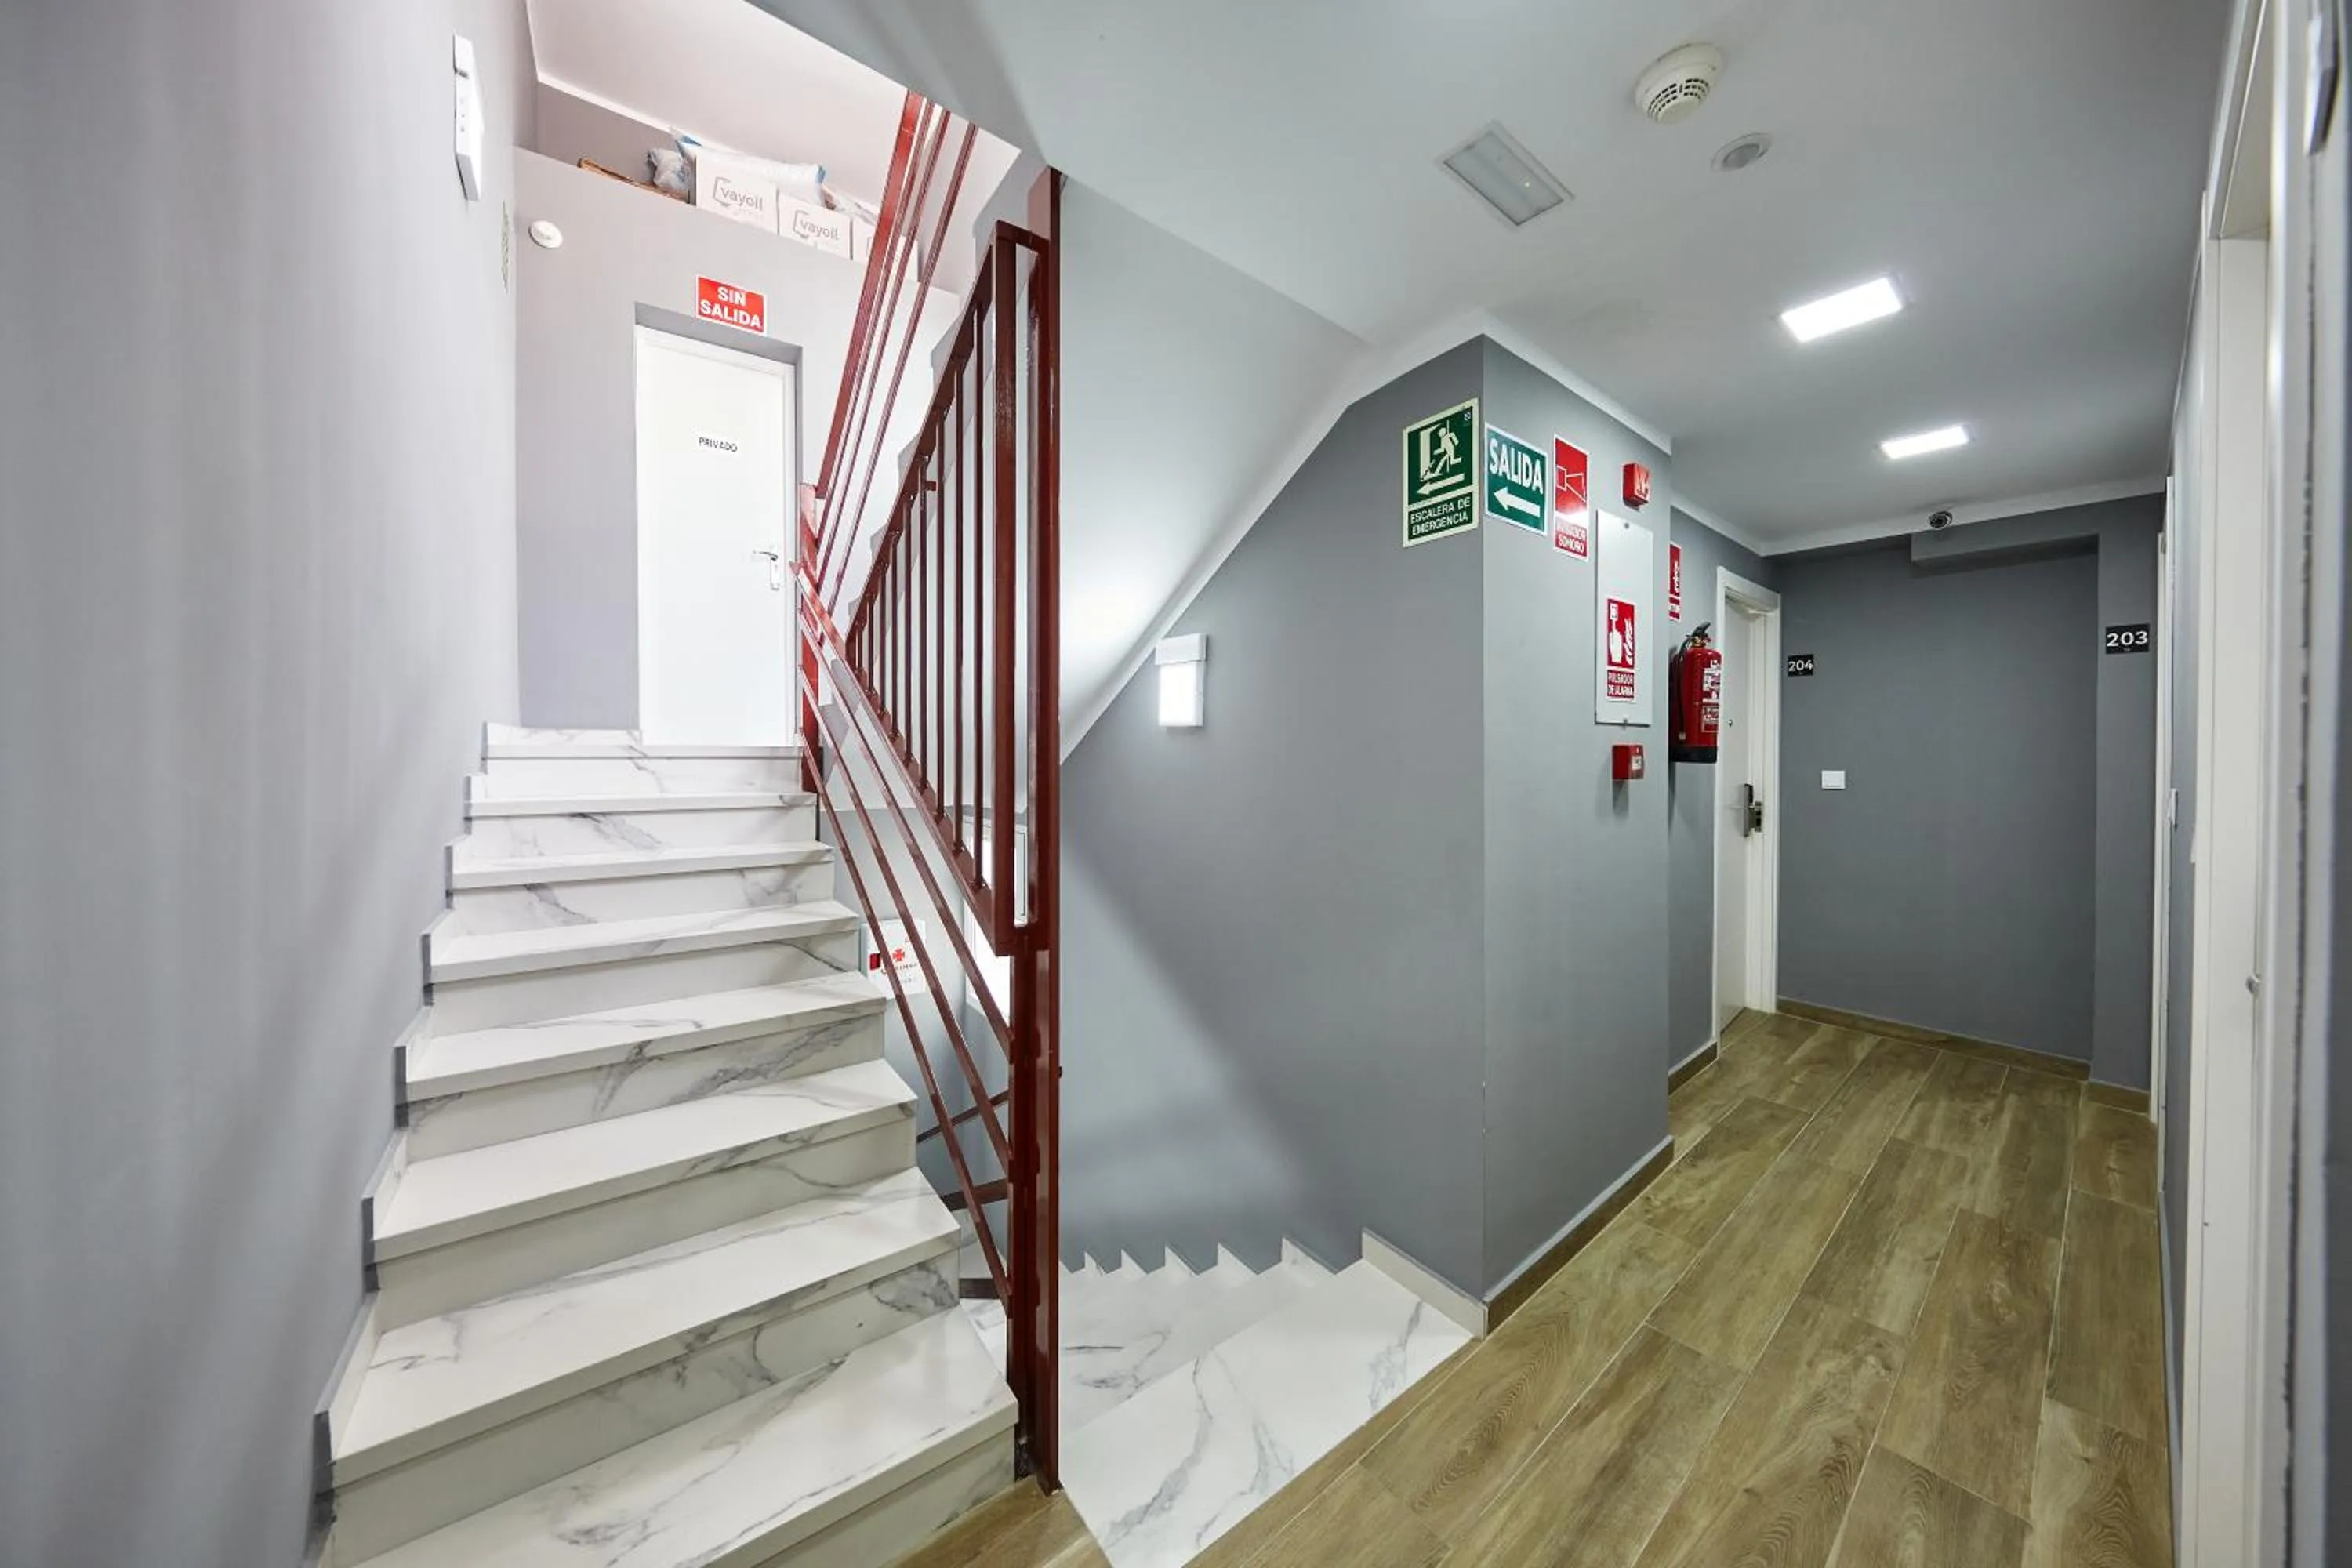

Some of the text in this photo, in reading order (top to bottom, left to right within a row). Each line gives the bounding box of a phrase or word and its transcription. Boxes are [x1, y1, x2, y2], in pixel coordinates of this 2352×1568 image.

[720, 186, 764, 210] vayoil
[800, 218, 839, 241] vayoil
[717, 286, 746, 307] SIN
[700, 299, 761, 329] SALIDA
[699, 437, 738, 452] PRIVADO
[1490, 437, 1544, 495] SALIDA
[1411, 496, 1471, 524] ESCALERA DE
[1412, 510, 1468, 536] EMERGENCIA
[1558, 533, 1584, 554] SONORO
[2107, 631, 2148, 647] 203
[1788, 659, 1813, 672] 204
